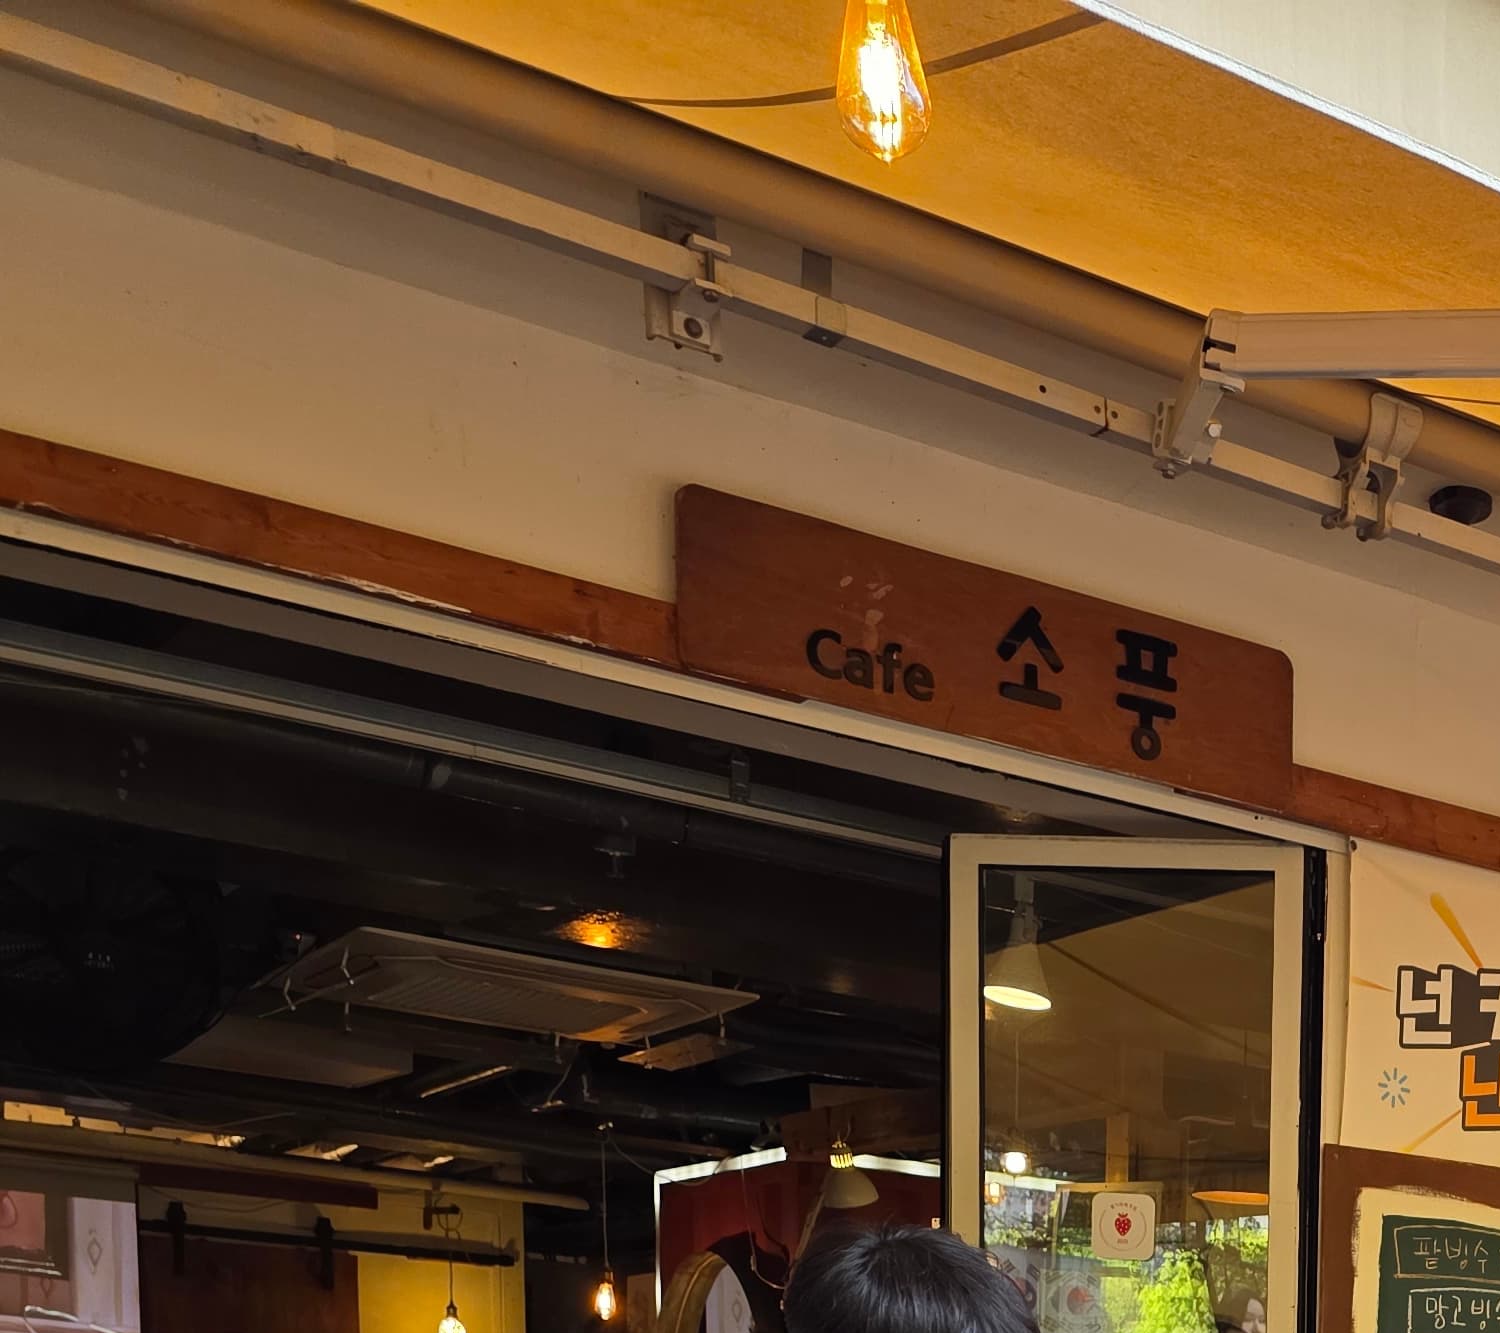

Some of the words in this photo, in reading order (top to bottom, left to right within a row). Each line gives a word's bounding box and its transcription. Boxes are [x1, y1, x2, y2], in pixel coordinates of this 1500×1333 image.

[805, 628, 936, 701] Cafe
[996, 605, 1179, 761] 소풍
[1398, 966, 1454, 1047] 넌
[1412, 1236, 1489, 1274] 팥빙수
